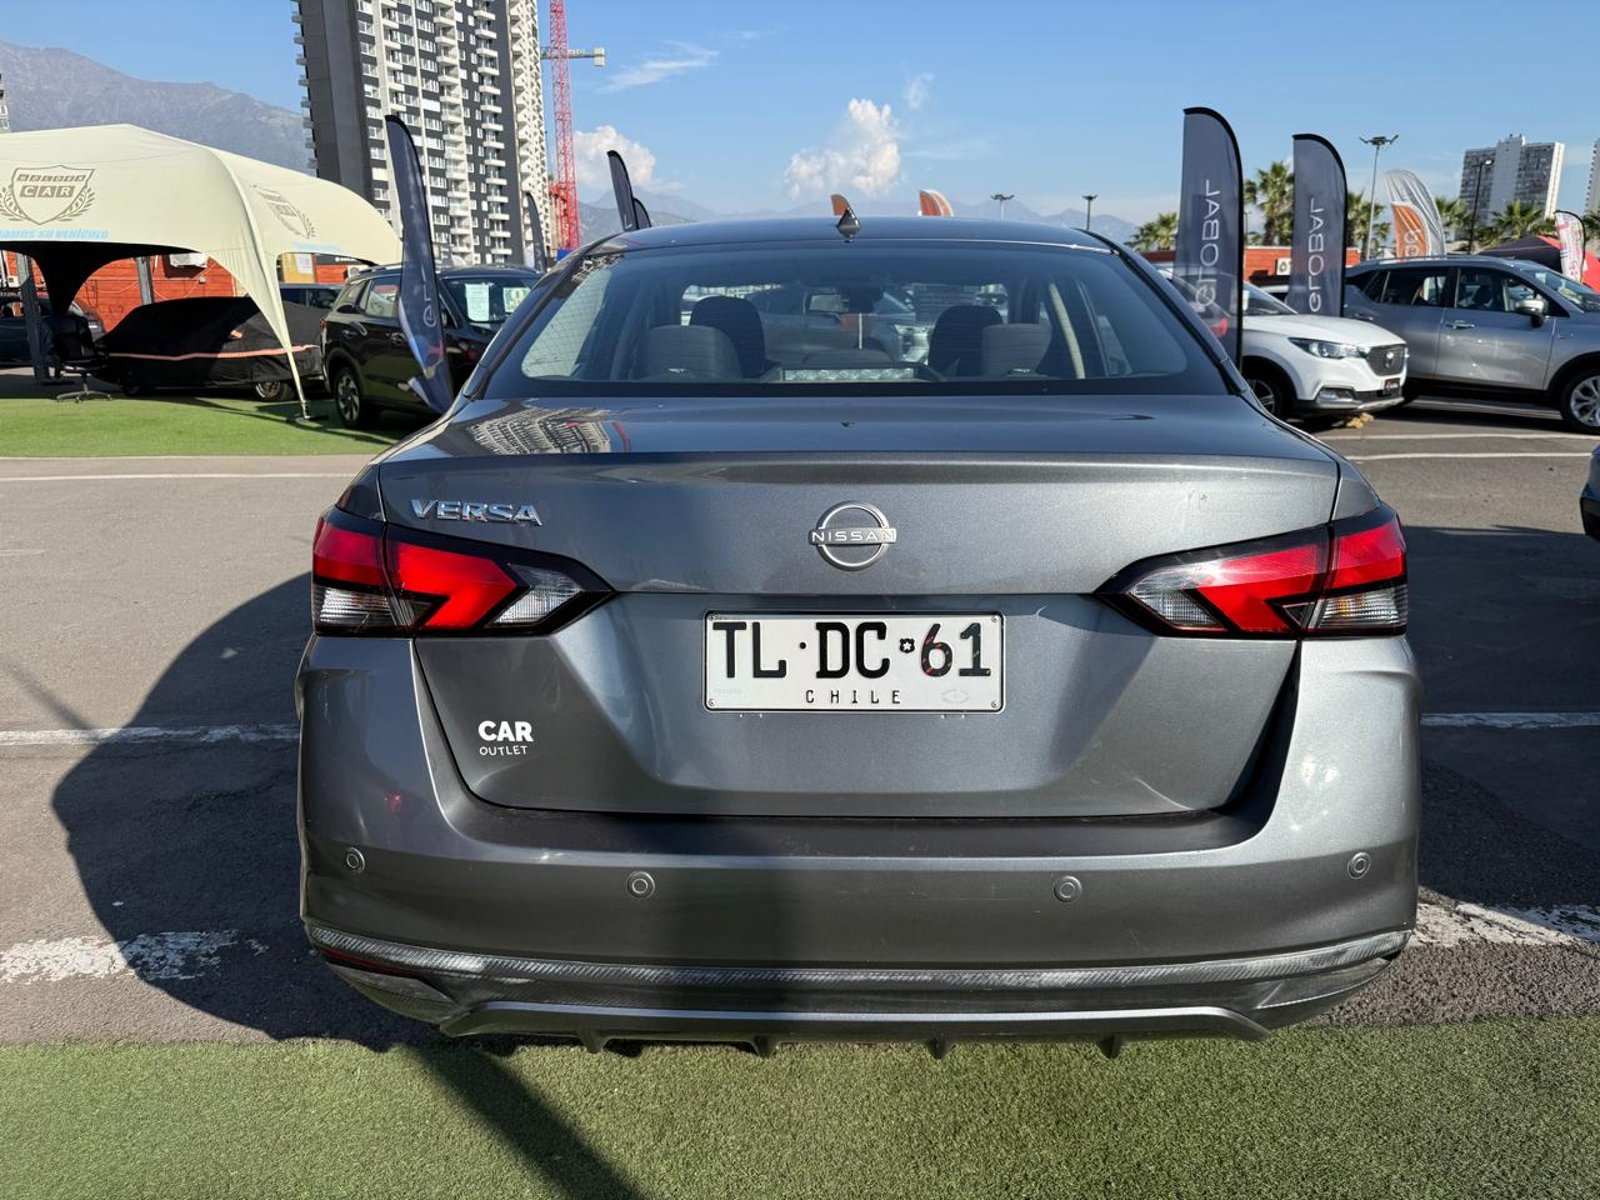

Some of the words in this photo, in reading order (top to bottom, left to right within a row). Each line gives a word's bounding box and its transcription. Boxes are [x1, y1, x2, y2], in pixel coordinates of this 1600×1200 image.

[22, 186, 73, 198] CAR
[411, 499, 543, 525] VERSA
[812, 530, 895, 543] NISSAN
[805, 689, 901, 704] CHILE
[478, 720, 535, 742] CAR
[479, 744, 529, 756] OUTLET
